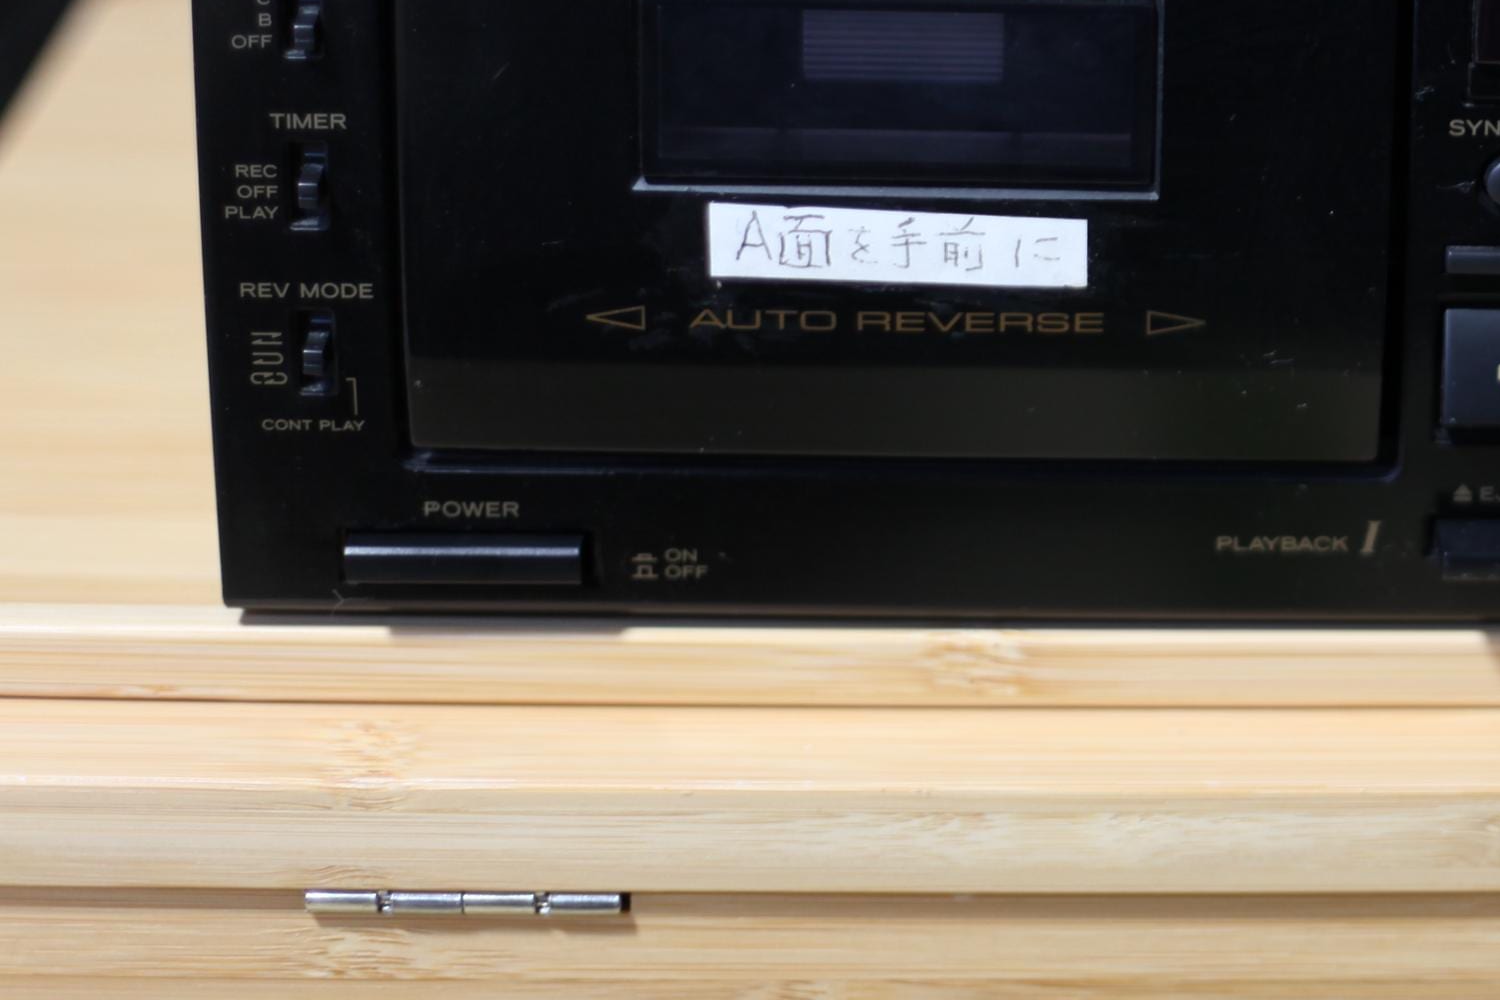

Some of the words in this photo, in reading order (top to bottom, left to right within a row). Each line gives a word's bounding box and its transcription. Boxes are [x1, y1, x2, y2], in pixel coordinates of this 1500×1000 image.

[258, 12, 272, 27] B
[231, 34, 273, 50] OFF
[269, 113, 347, 130] TIMER
[235, 164, 277, 179] REC
[236, 185, 279, 199] OFF
[225, 206, 279, 219] PLAY
[735, 210, 1062, 271] A面を手前に
[239, 282, 290, 298] REV
[300, 282, 374, 299] MODE
[690, 308, 837, 331] AUTO
[856, 310, 1105, 333] REVERSE
[261, 419, 313, 431] CONT
[319, 419, 365, 431] PLAY
[423, 501, 520, 518] POWER
[1215, 535, 1349, 552] PLAYBACK
[664, 548, 698, 562] ON
[664, 565, 708, 579] OFF
